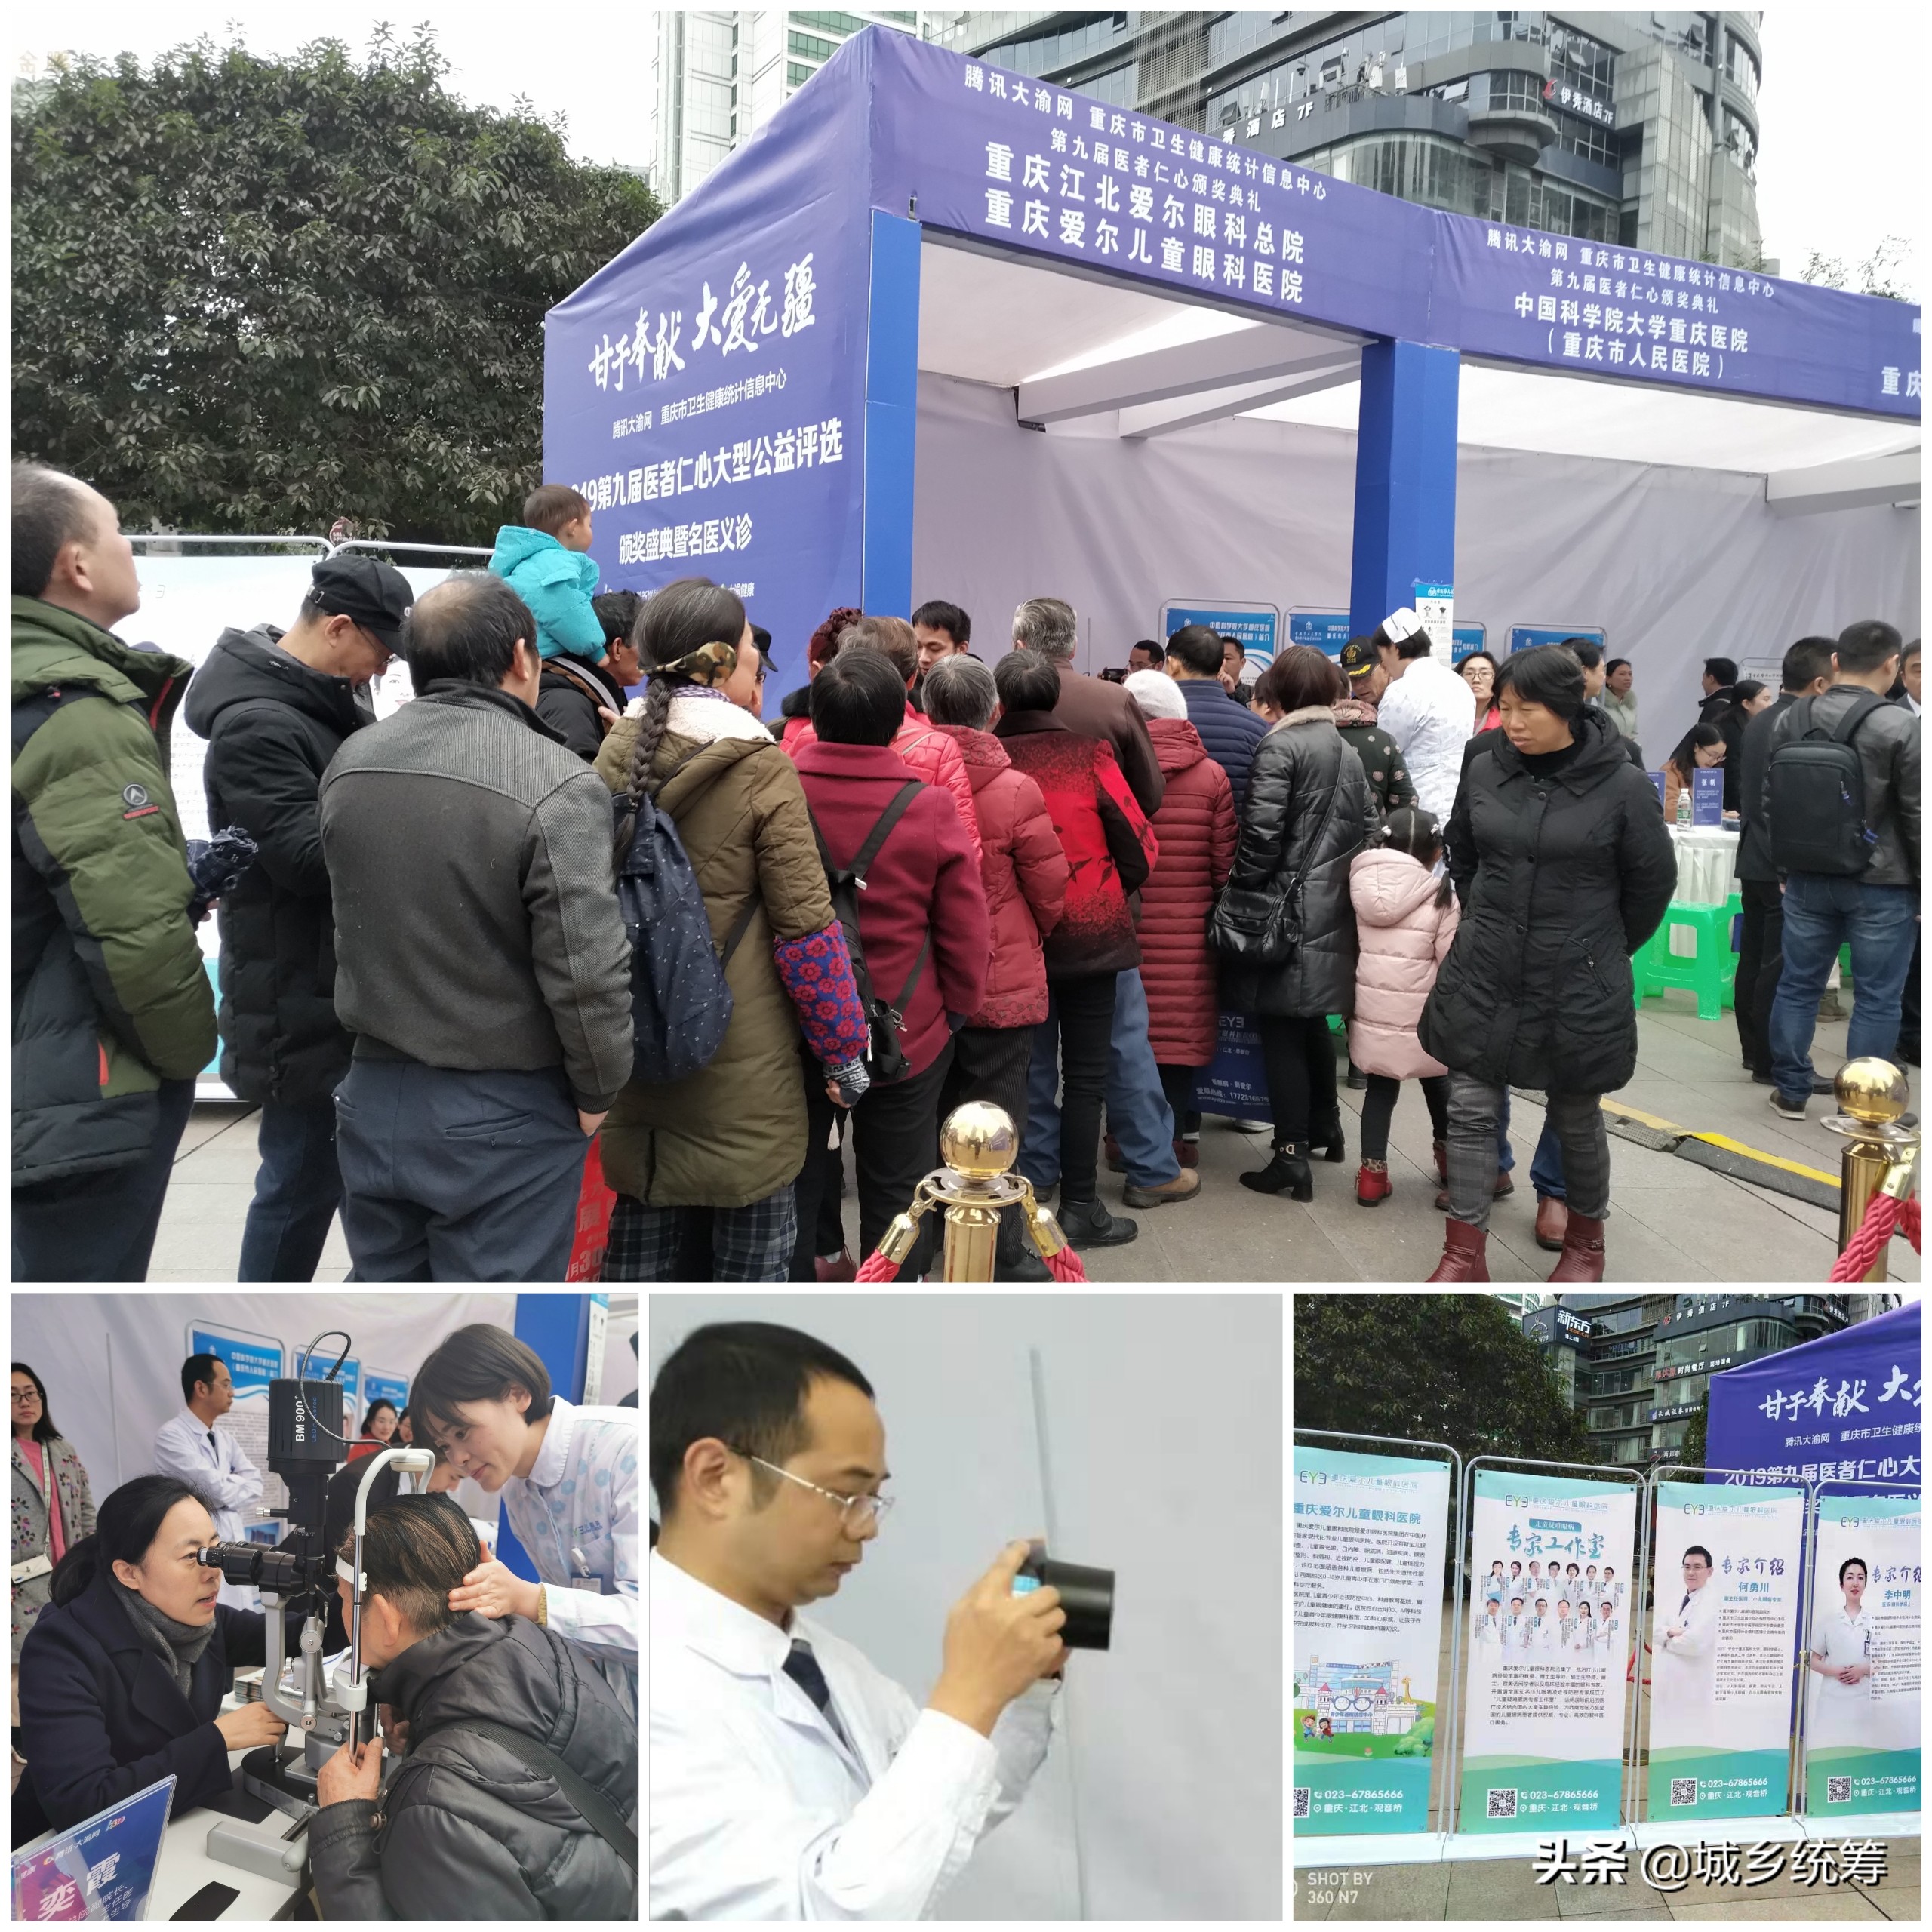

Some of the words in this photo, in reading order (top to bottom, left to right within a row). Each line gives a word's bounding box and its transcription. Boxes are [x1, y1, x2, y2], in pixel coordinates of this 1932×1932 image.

[1297, 101, 1314, 121] 7F
[1561, 86, 1604, 120] 伊秀酒店
[1604, 109, 1614, 125] 7F
[964, 64, 1073, 121] 腾讯大渝网
[1090, 106, 1327, 201] 重庆市卫生健康统计信息中心
[1051, 128, 1261, 212] 第九届医者仁心颁奖典礼
[985, 141, 1304, 264] 重庆江北爱尔眼科总院
[984, 190, 1303, 303] 重庆爱尔儿童眼科医院
[1487, 229, 1569, 262] 腾讯大渝网
[1580, 246, 1775, 297] 重庆市卫生健康统计信息中心
[1550, 268, 1720, 315] 第九届医者仁心颁奖典礼
[588, 307, 685, 392] 甘于奉献
[691, 252, 817, 358] 大爱无疆
[1515, 291, 1749, 353] 中国科学院大学重庆医院
[612, 410, 653, 440] 腾讯大渝网
[660, 368, 787, 426] 重庆市卫生健康统计信息中心
[571, 417, 844, 513] 19第九届医者仁心大型公益评选
[619, 512, 752, 565] 颁奖盛典暨名医义诊
[1557, 1309, 1592, 1334] 新东方
[1758, 1376, 1869, 1422] 甘于奉献
[295, 1424, 305, 1442] BM
[1785, 1432, 1830, 1447] 腾讯大渝网
[1294, 1502, 1421, 1524] 重庆爱尔儿童眼科医院
[1506, 1524, 1604, 1561] 专家工作室
[1721, 1555, 1785, 1576] 专家介绍
[1738, 1582, 1769, 1593] 何勇川
[1884, 1589, 1911, 1601] 李中明
